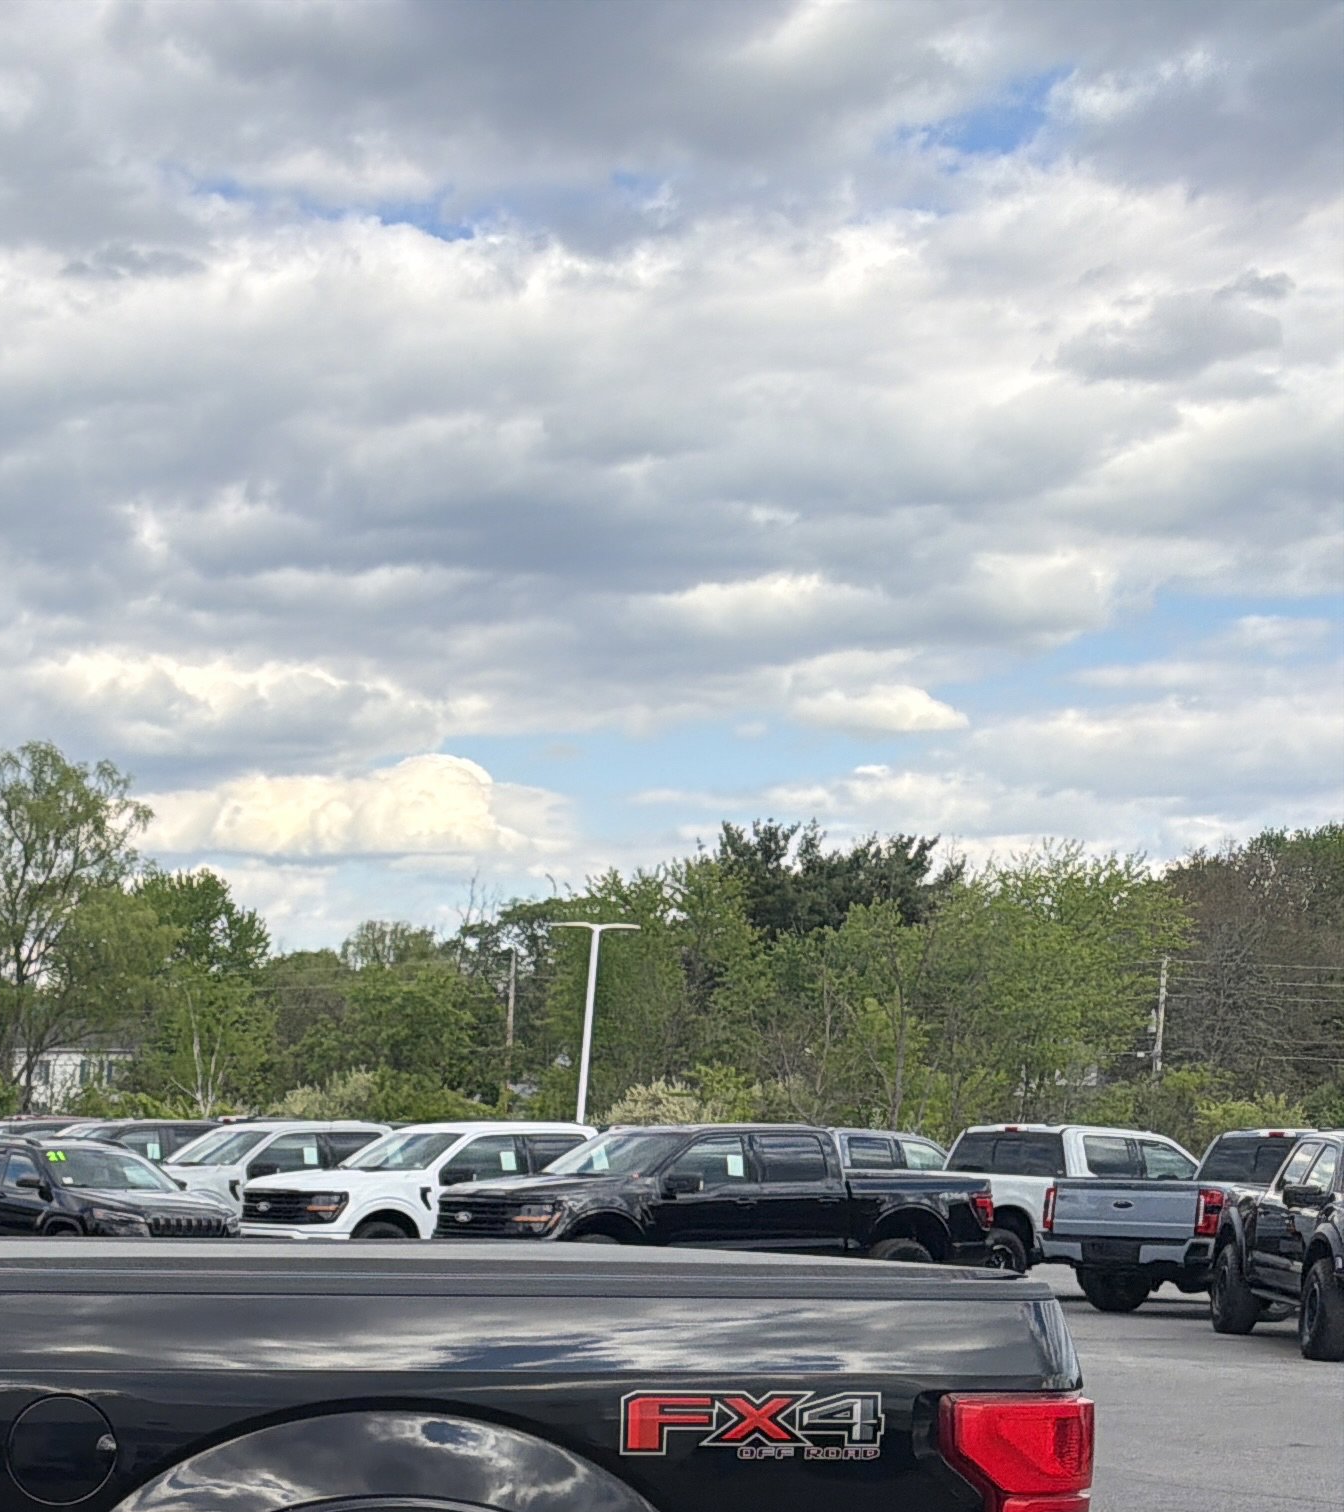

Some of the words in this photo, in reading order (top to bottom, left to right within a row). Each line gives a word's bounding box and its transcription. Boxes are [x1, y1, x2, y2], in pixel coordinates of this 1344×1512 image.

[46, 1150, 66, 1161] 21
[619, 1390, 884, 1456] FX4
[737, 1447, 794, 1459] OFF
[804, 1447, 881, 1460] ROAD
